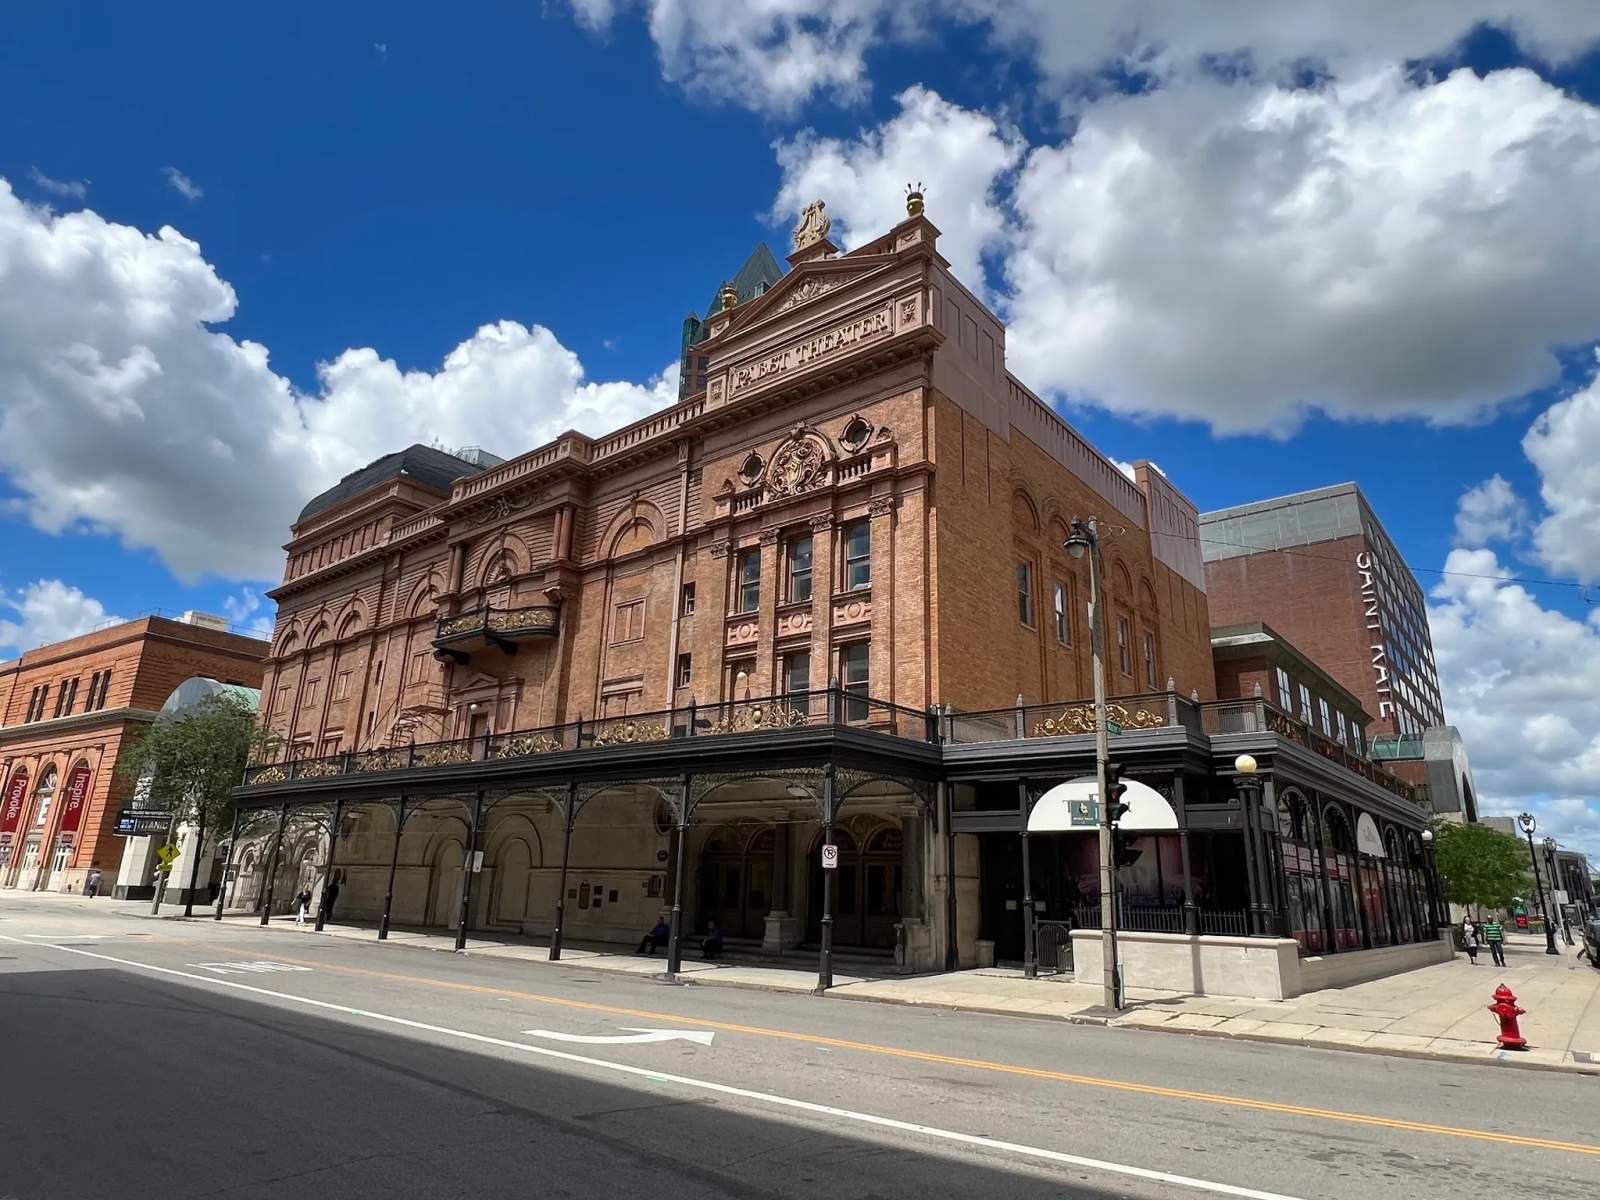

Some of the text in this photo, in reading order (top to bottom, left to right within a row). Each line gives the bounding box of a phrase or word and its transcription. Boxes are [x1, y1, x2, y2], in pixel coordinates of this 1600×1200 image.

[735, 313, 888, 388] PABST THEATER
[1356, 552, 1394, 718] SAINT KATE
[6, 779, 27, 820] Provoke.
[69, 773, 89, 811] Inspire.
